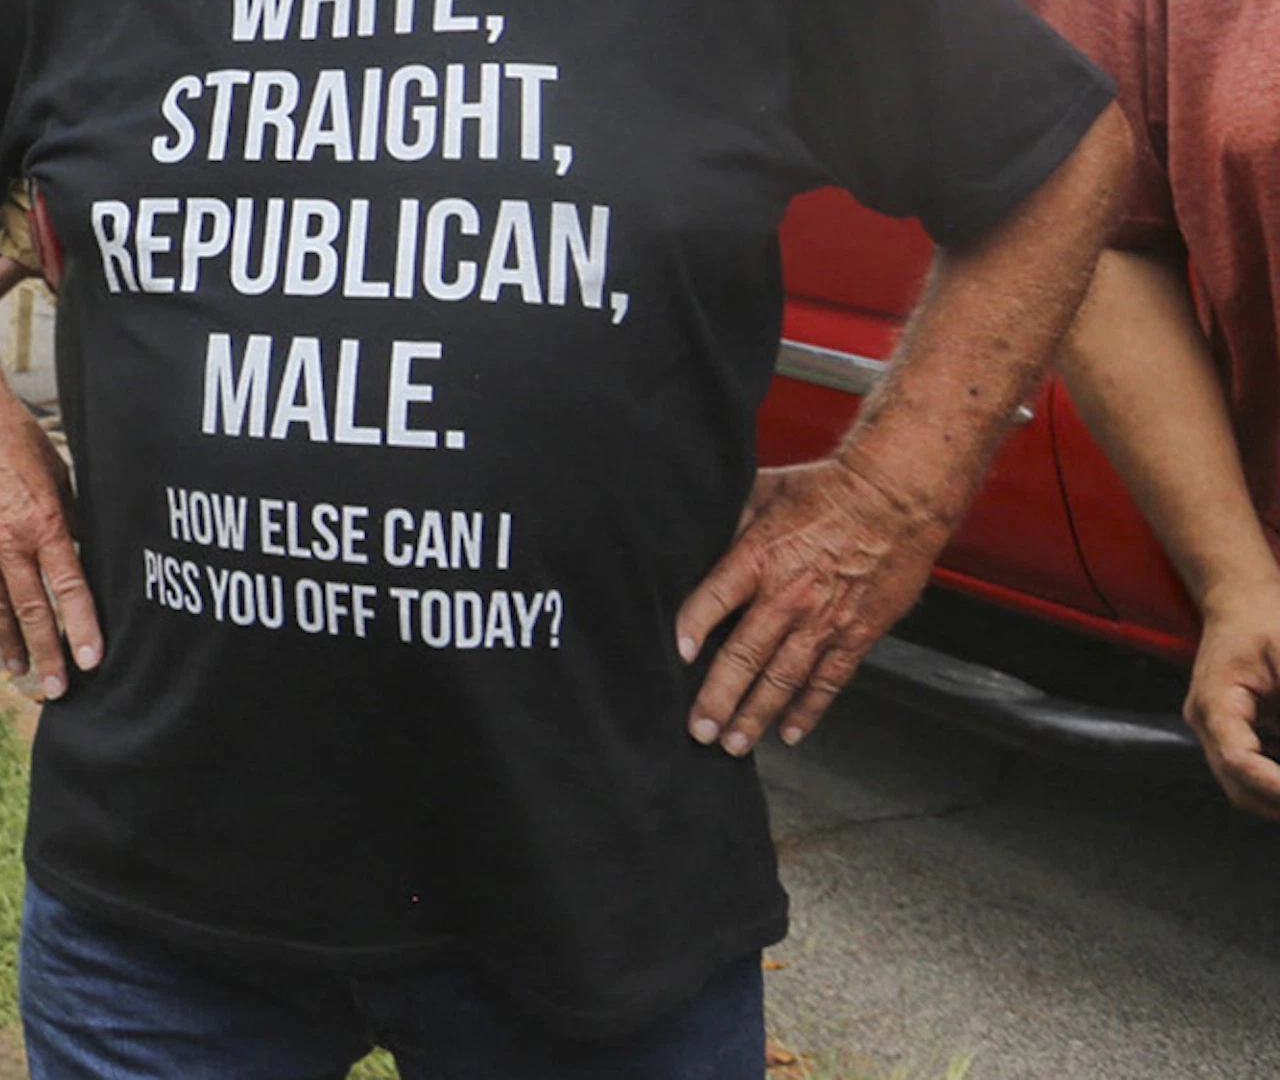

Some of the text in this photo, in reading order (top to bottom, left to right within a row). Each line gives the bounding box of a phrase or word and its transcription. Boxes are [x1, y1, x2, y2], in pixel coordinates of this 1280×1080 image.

[151, 62, 574, 176] STRAIGHT,
[91, 197, 630, 325] REPUBLICAN,
[201, 332, 466, 450] MALE.
[166, 485, 512, 570] HOW ELSE CAN I
[144, 548, 563, 650] PISS YOU OFF TODAY?
